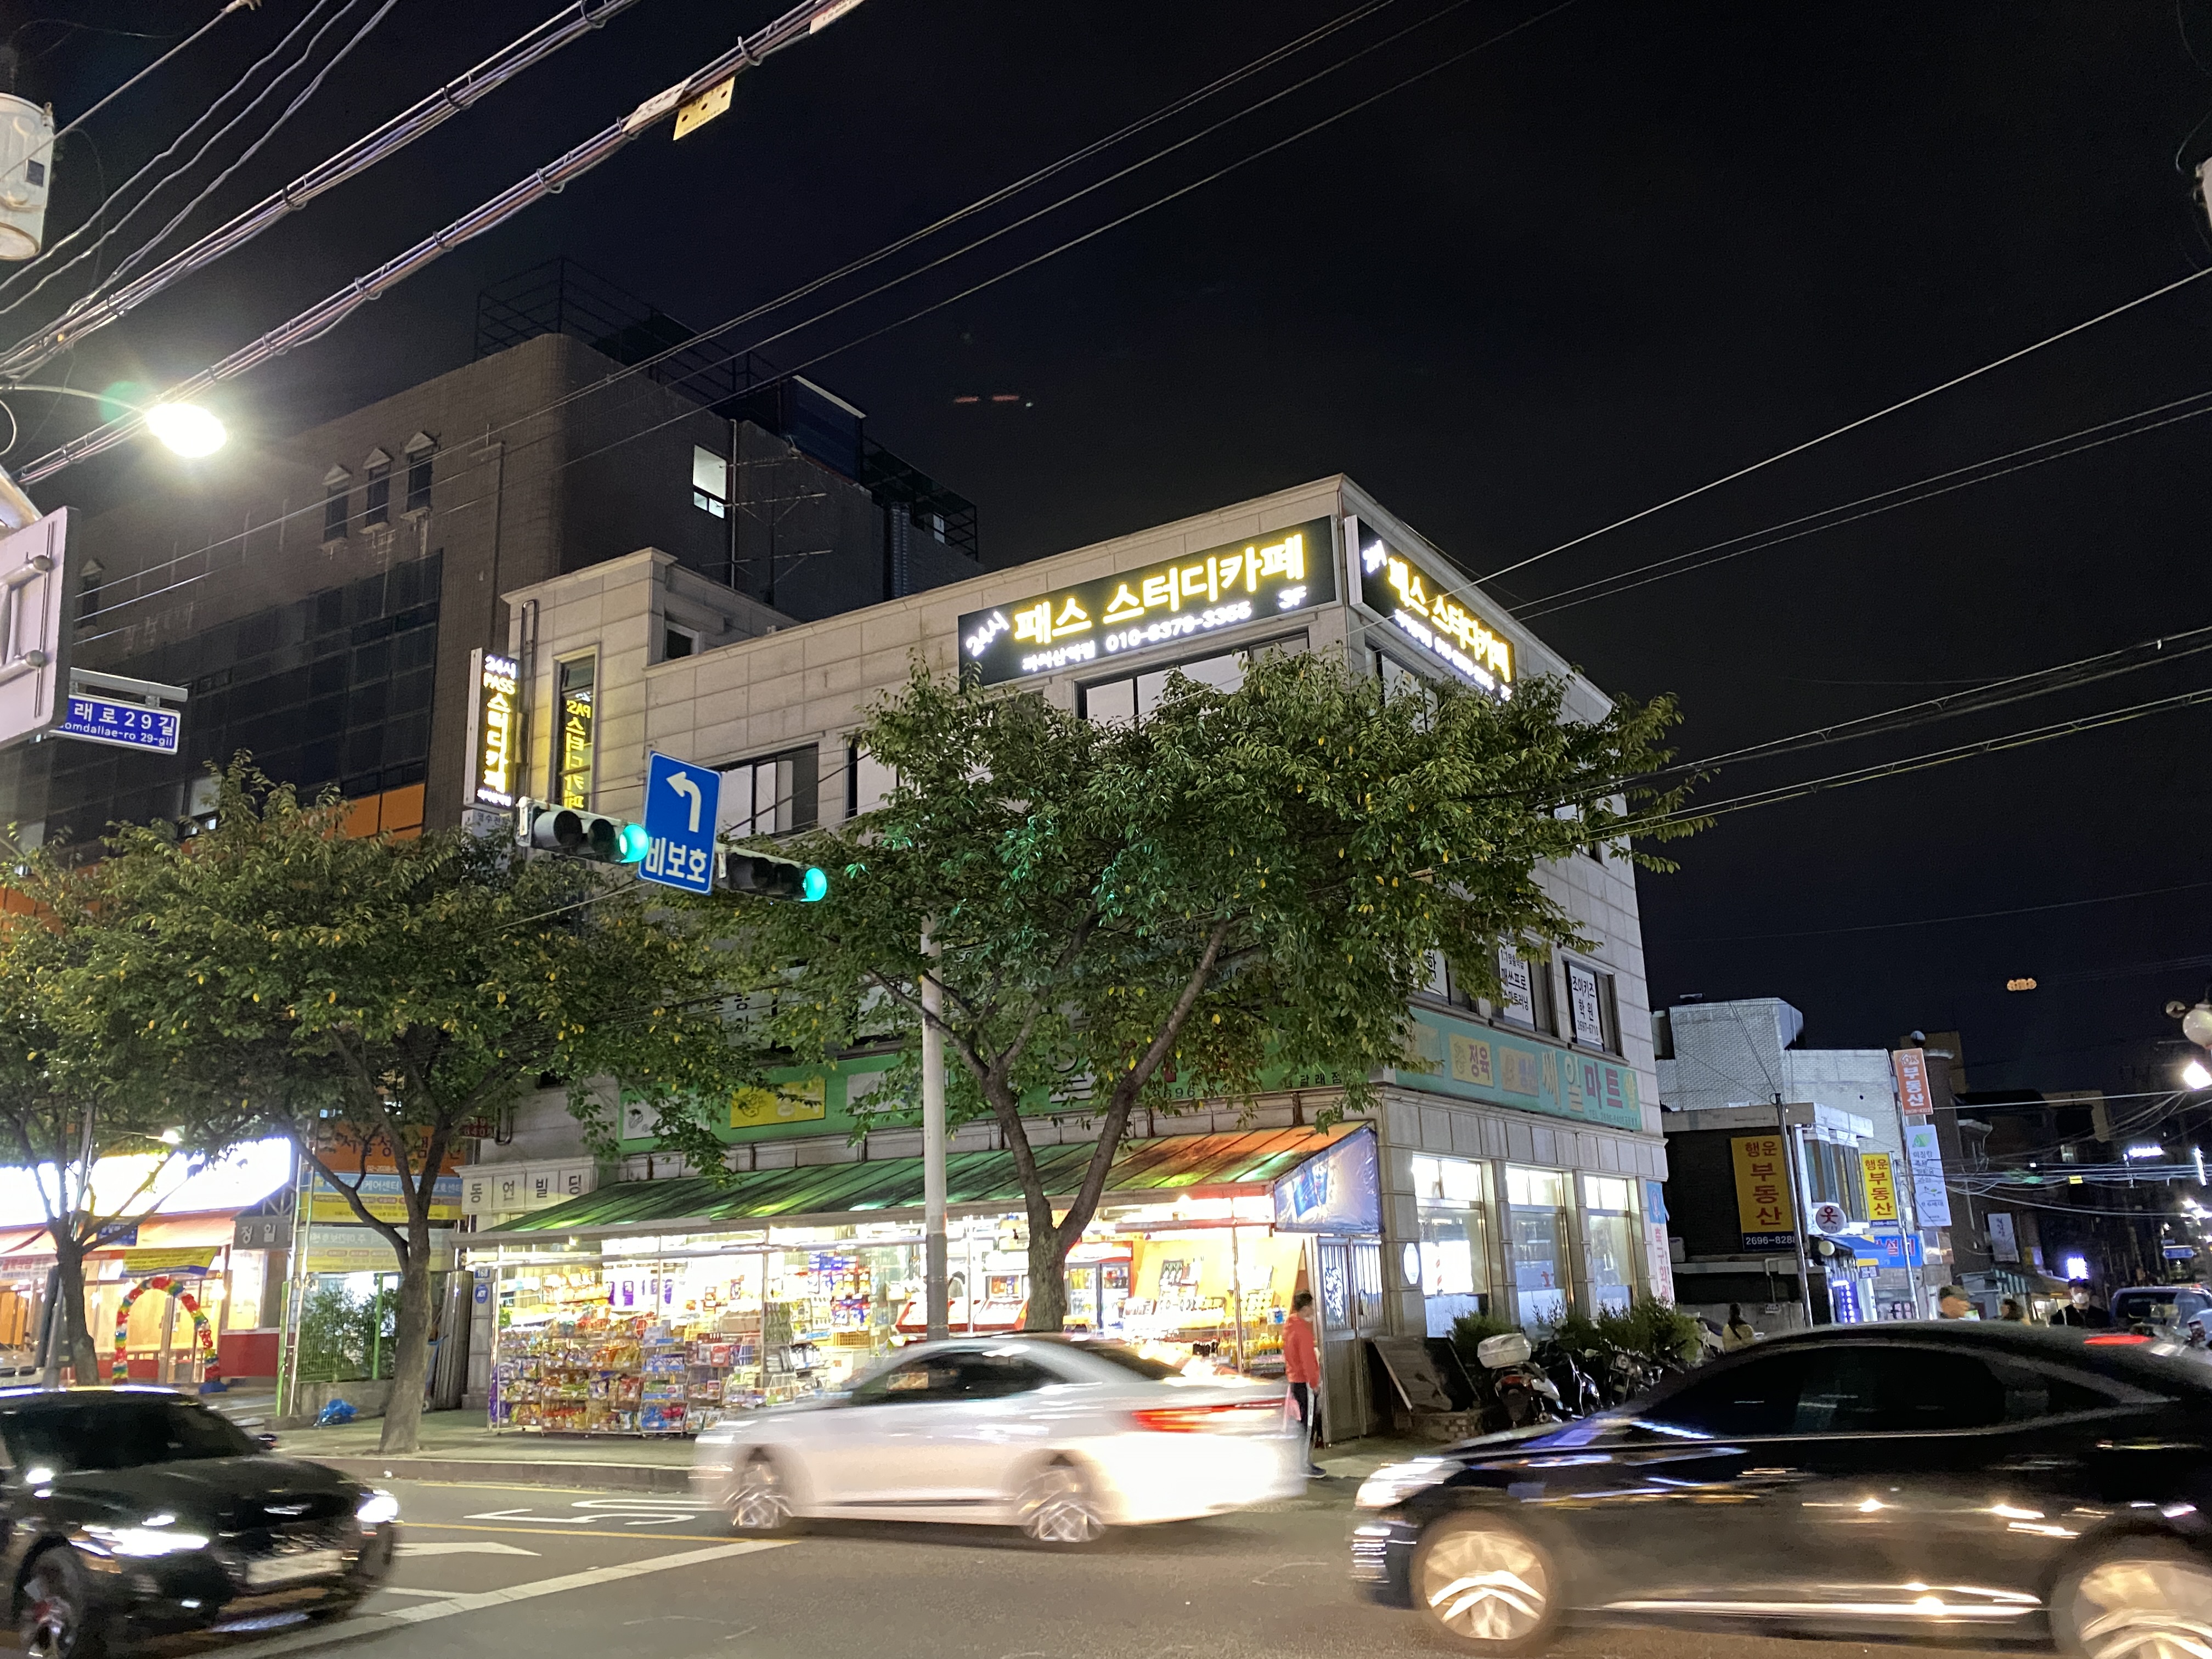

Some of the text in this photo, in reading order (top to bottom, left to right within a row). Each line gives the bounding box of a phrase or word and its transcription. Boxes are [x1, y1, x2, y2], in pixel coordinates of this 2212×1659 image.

[1014, 597, 1092, 644] 패스
[1103, 534, 1305, 624] 스터디카페
[966, 611, 1010, 657] 24시
[483, 672, 516, 695] PASS
[140, 732, 172, 747] 29-gil
[483, 693, 511, 793] 스터디카페
[646, 837, 707, 883] 비보호
[1572, 976, 1595, 999] 조이키즈
[1469, 1045, 1489, 1081] 정육
[1904, 1066, 1924, 1107] 부동산
[1745, 1141, 1777, 1157] 행운
[1865, 1159, 1888, 1171] 행운
[1750, 1163, 1782, 1226] 부동산
[1869, 1173, 1893, 1216] 부동산
